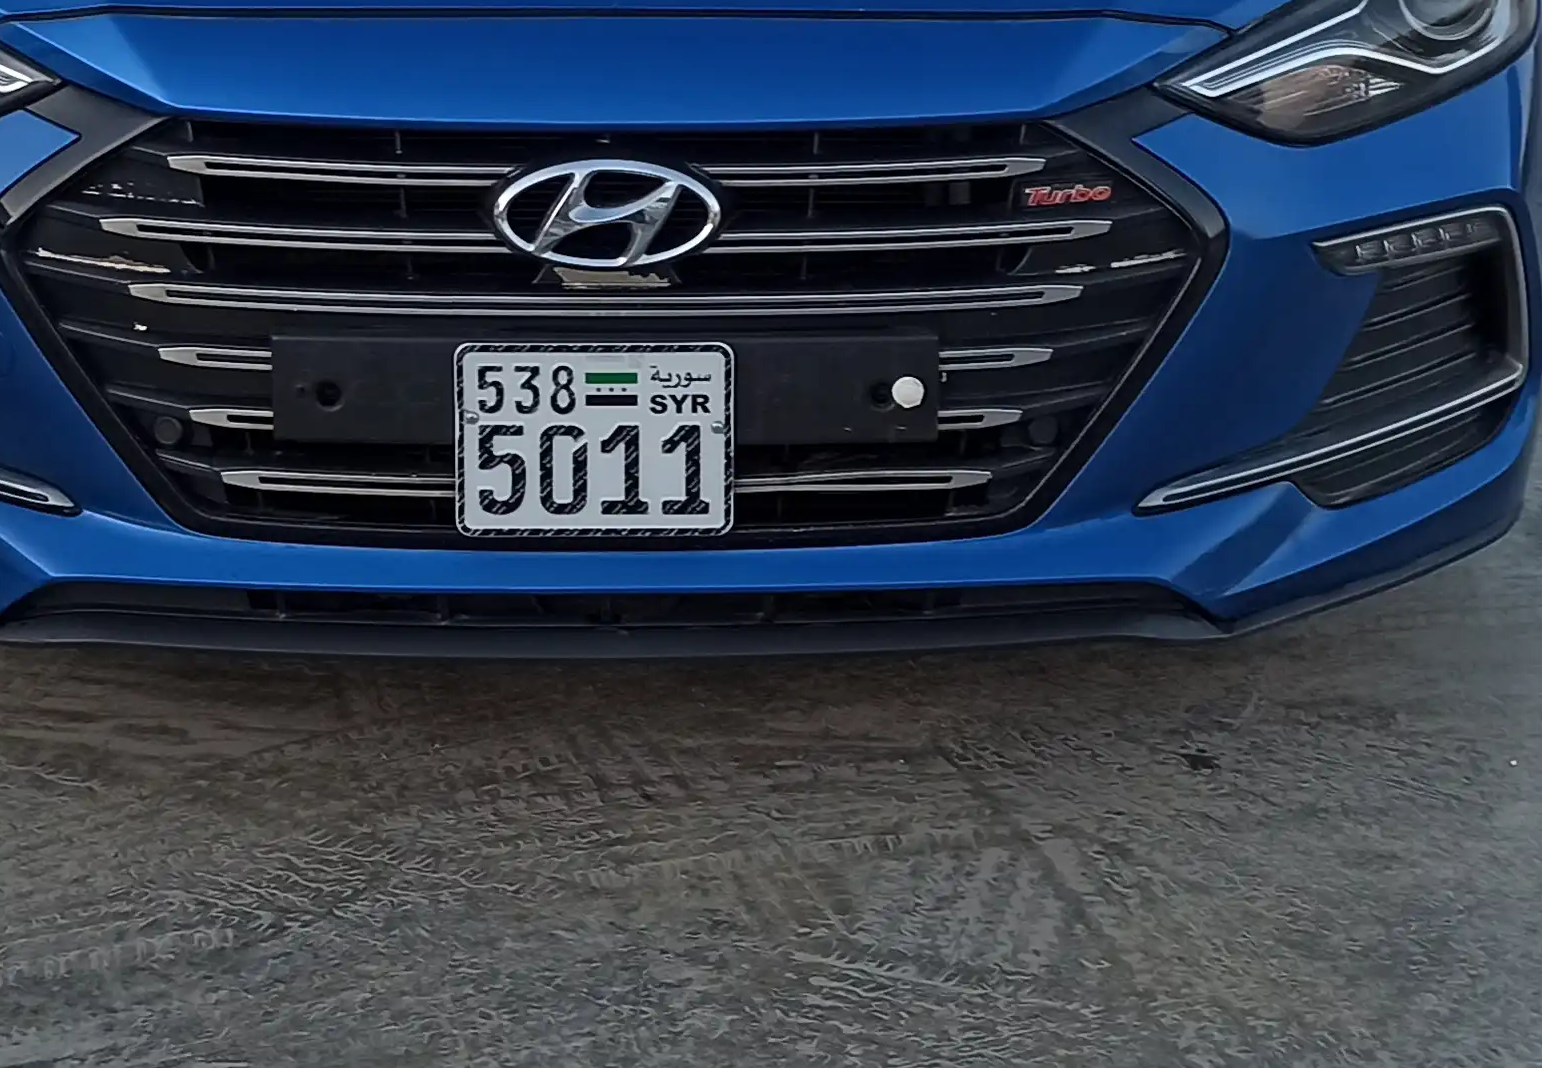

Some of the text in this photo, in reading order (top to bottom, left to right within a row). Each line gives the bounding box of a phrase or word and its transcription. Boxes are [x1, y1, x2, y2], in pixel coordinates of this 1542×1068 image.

[1025, 184, 1112, 207] Turbo
[649, 365, 712, 388] سورية
[477, 365, 576, 414] 538
[649, 394, 711, 414] SYR
[478, 425, 711, 516] 5011
